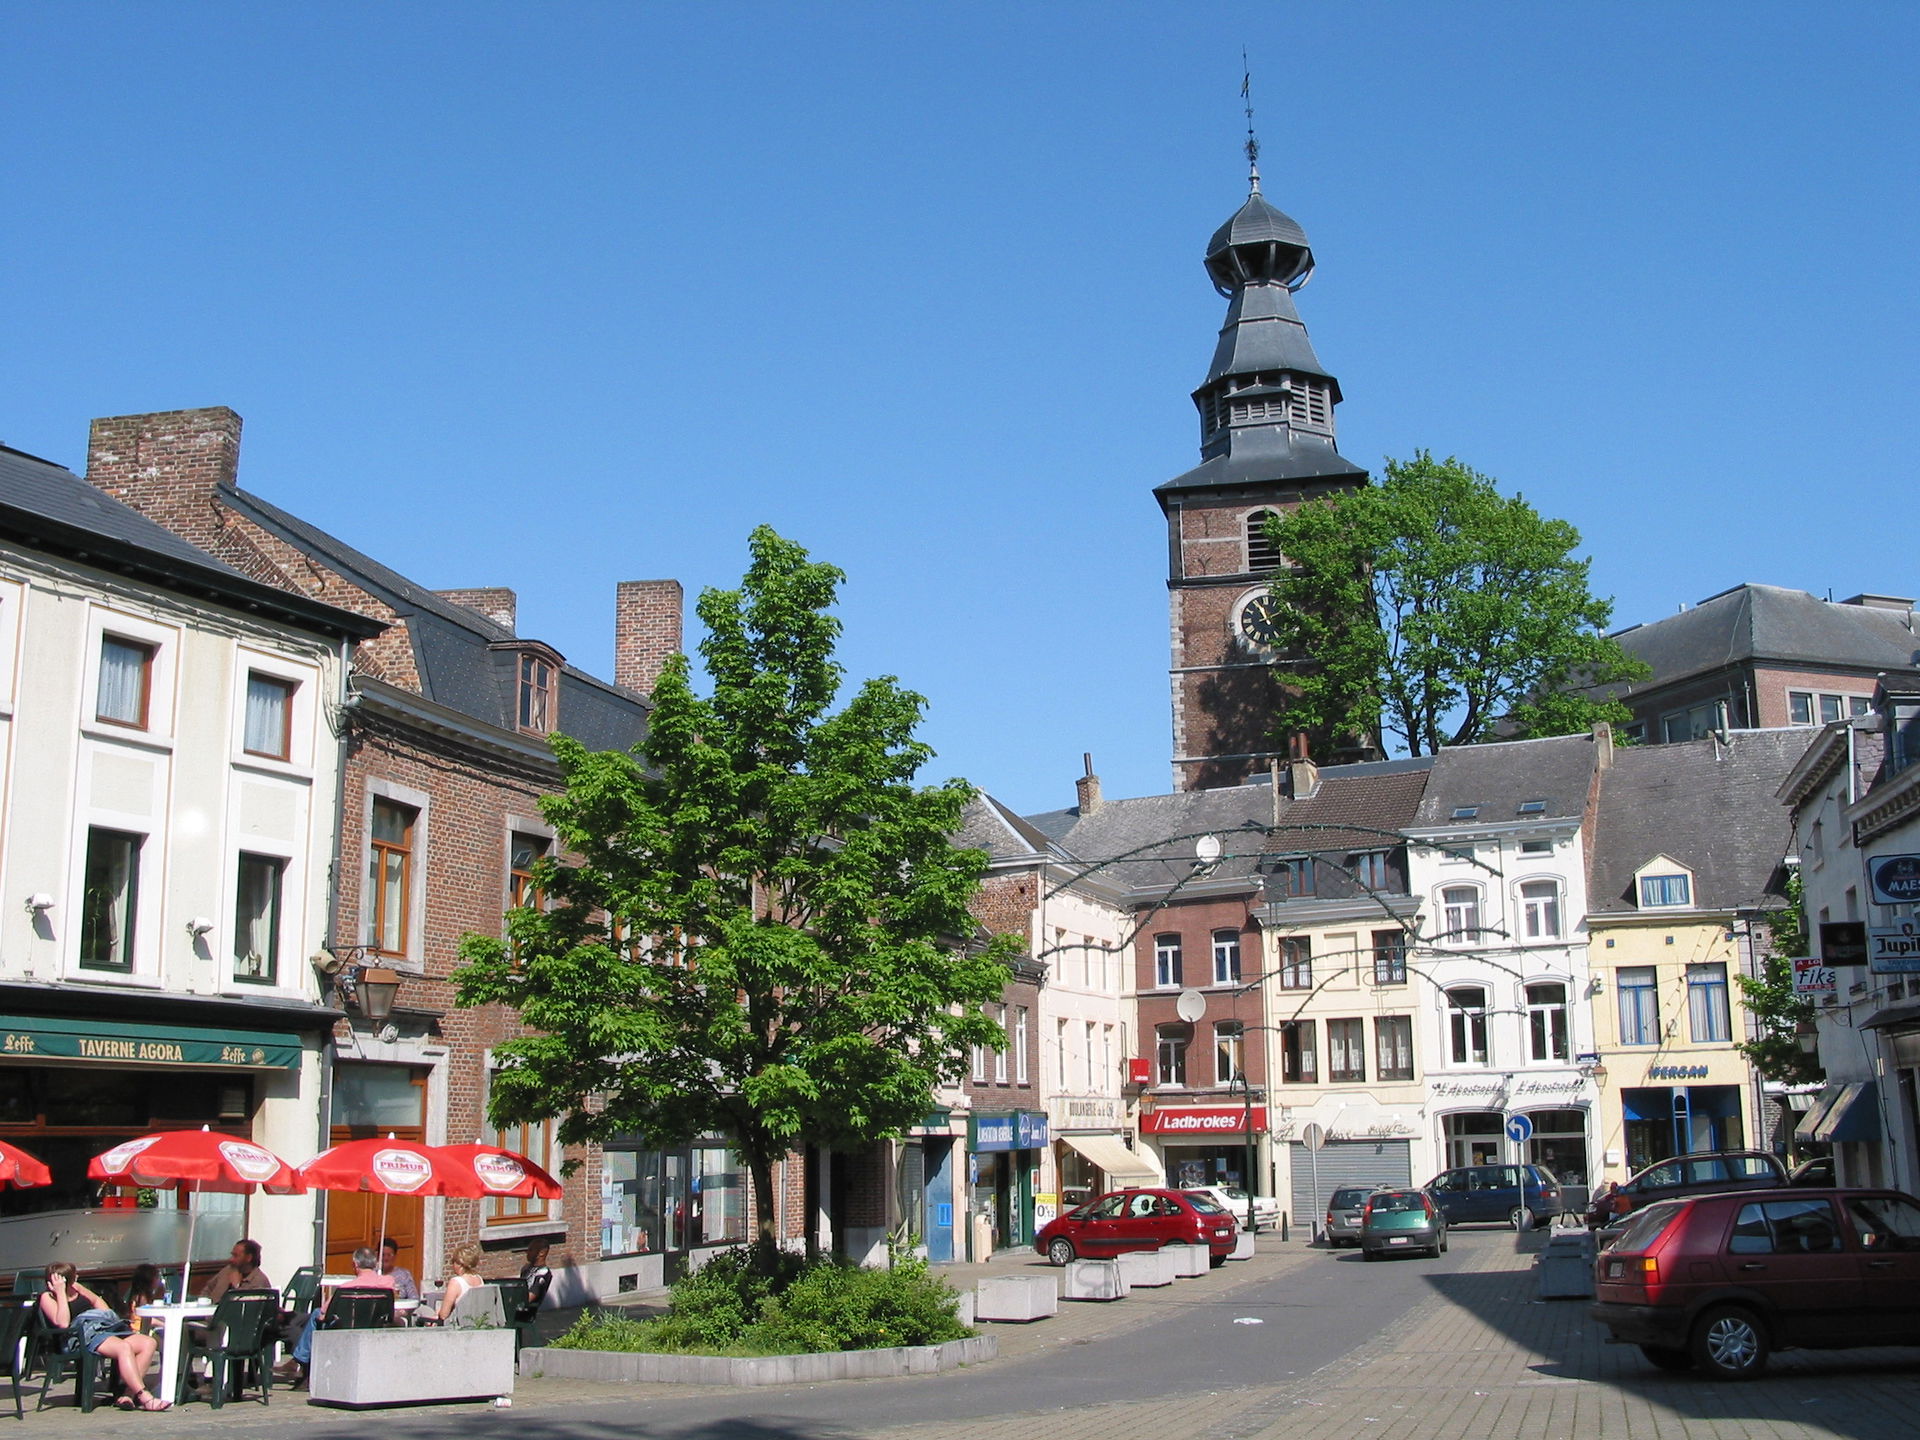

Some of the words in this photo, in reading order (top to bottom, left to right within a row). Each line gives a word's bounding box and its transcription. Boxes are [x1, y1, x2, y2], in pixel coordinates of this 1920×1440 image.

[1888, 880, 1920, 892] MAE
[4, 1034, 35, 1054] Leffe
[79, 1039, 136, 1058] TAVERNE
[139, 1043, 183, 1061] AGORA
[221, 1046, 246, 1063] Leffe
[1163, 1115, 1236, 1129] Ladbrokes
[380, 1161, 424, 1170] PRIMUS
